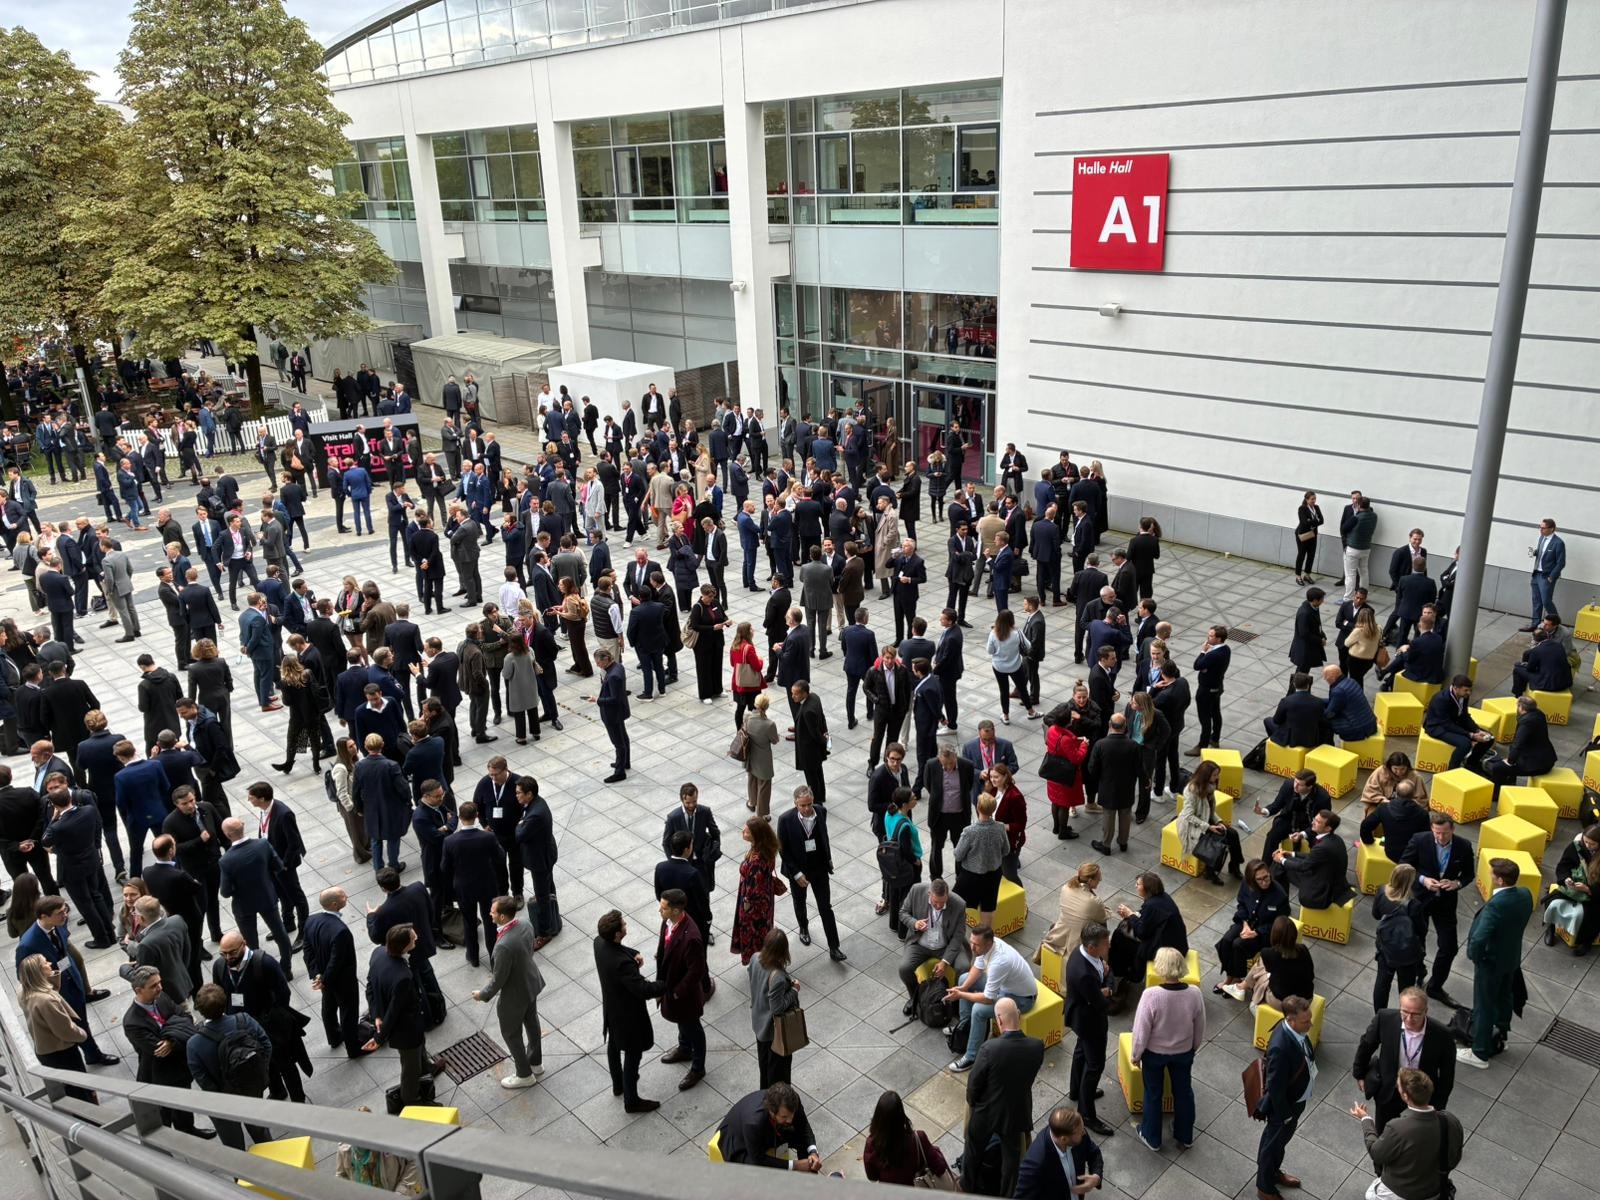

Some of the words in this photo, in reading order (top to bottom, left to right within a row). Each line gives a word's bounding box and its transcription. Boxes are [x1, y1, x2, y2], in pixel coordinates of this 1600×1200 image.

[1078, 161, 1106, 174] Halle
[1109, 160, 1133, 173] Hall
[1098, 195, 1161, 243] A1
[321, 434, 339, 442] Visit
[339, 432, 354, 440] Hall
[1545, 712, 1566, 723] vills
[1387, 723, 1420, 735] savills
[1417, 759, 1448, 774] savill
[1430, 798, 1460, 821] savills
[1463, 807, 1491, 821] savills
[1161, 853, 1196, 875] savills
[1302, 923, 1346, 943] savills
